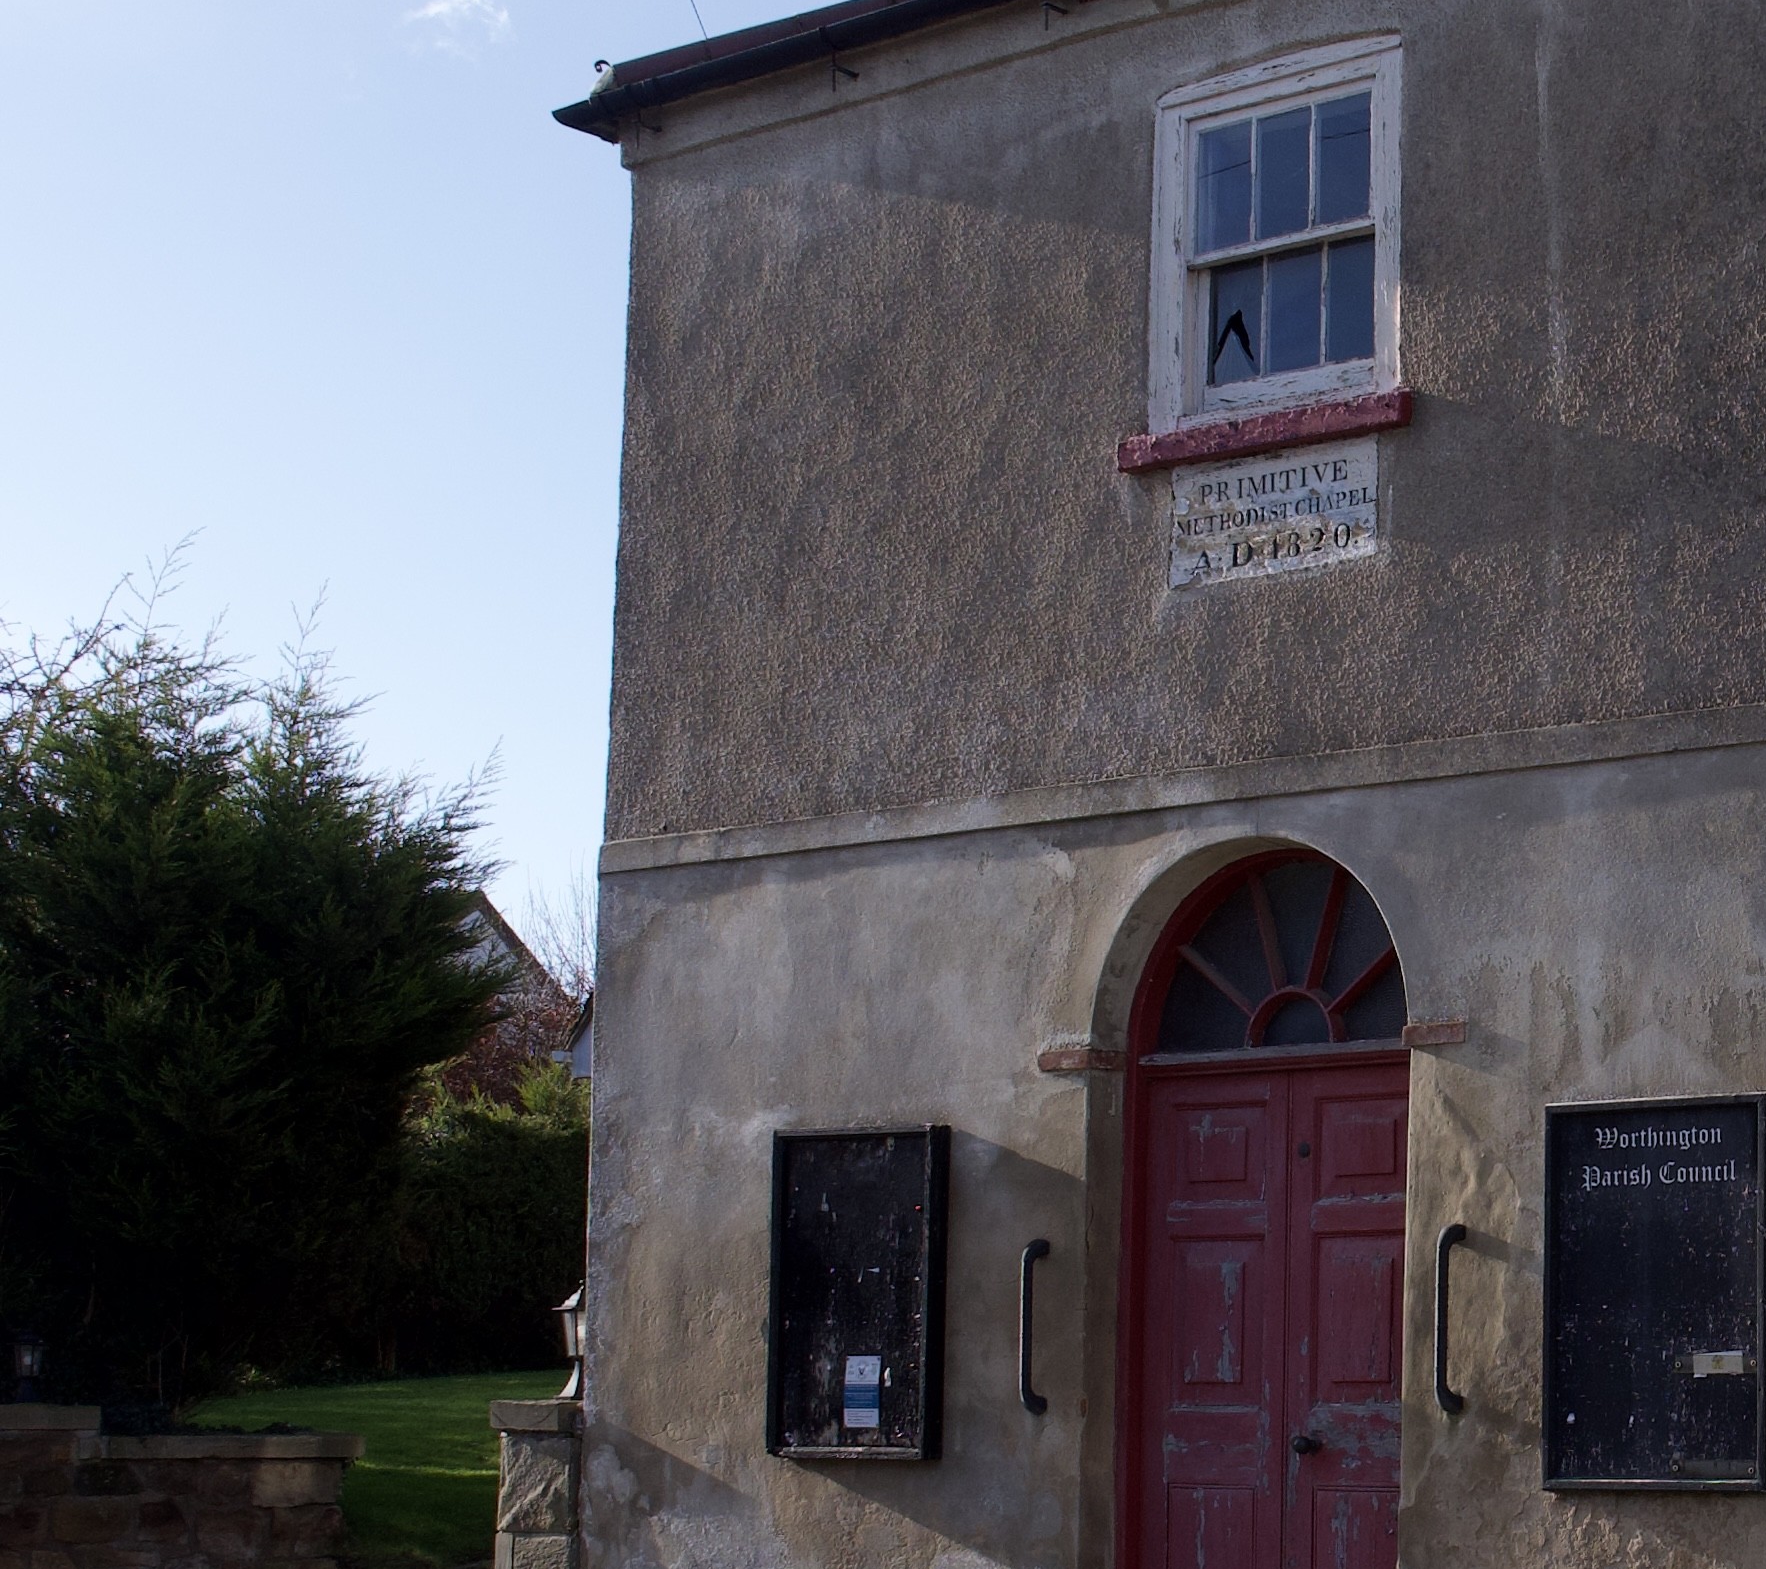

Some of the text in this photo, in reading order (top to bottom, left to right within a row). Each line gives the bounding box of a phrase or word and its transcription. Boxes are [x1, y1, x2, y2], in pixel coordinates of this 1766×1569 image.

[1200, 459, 1348, 505] PRIMITIVE
[1595, 1126, 1722, 1150] Worthington
[1581, 1159, 1736, 1192] Parish Council
